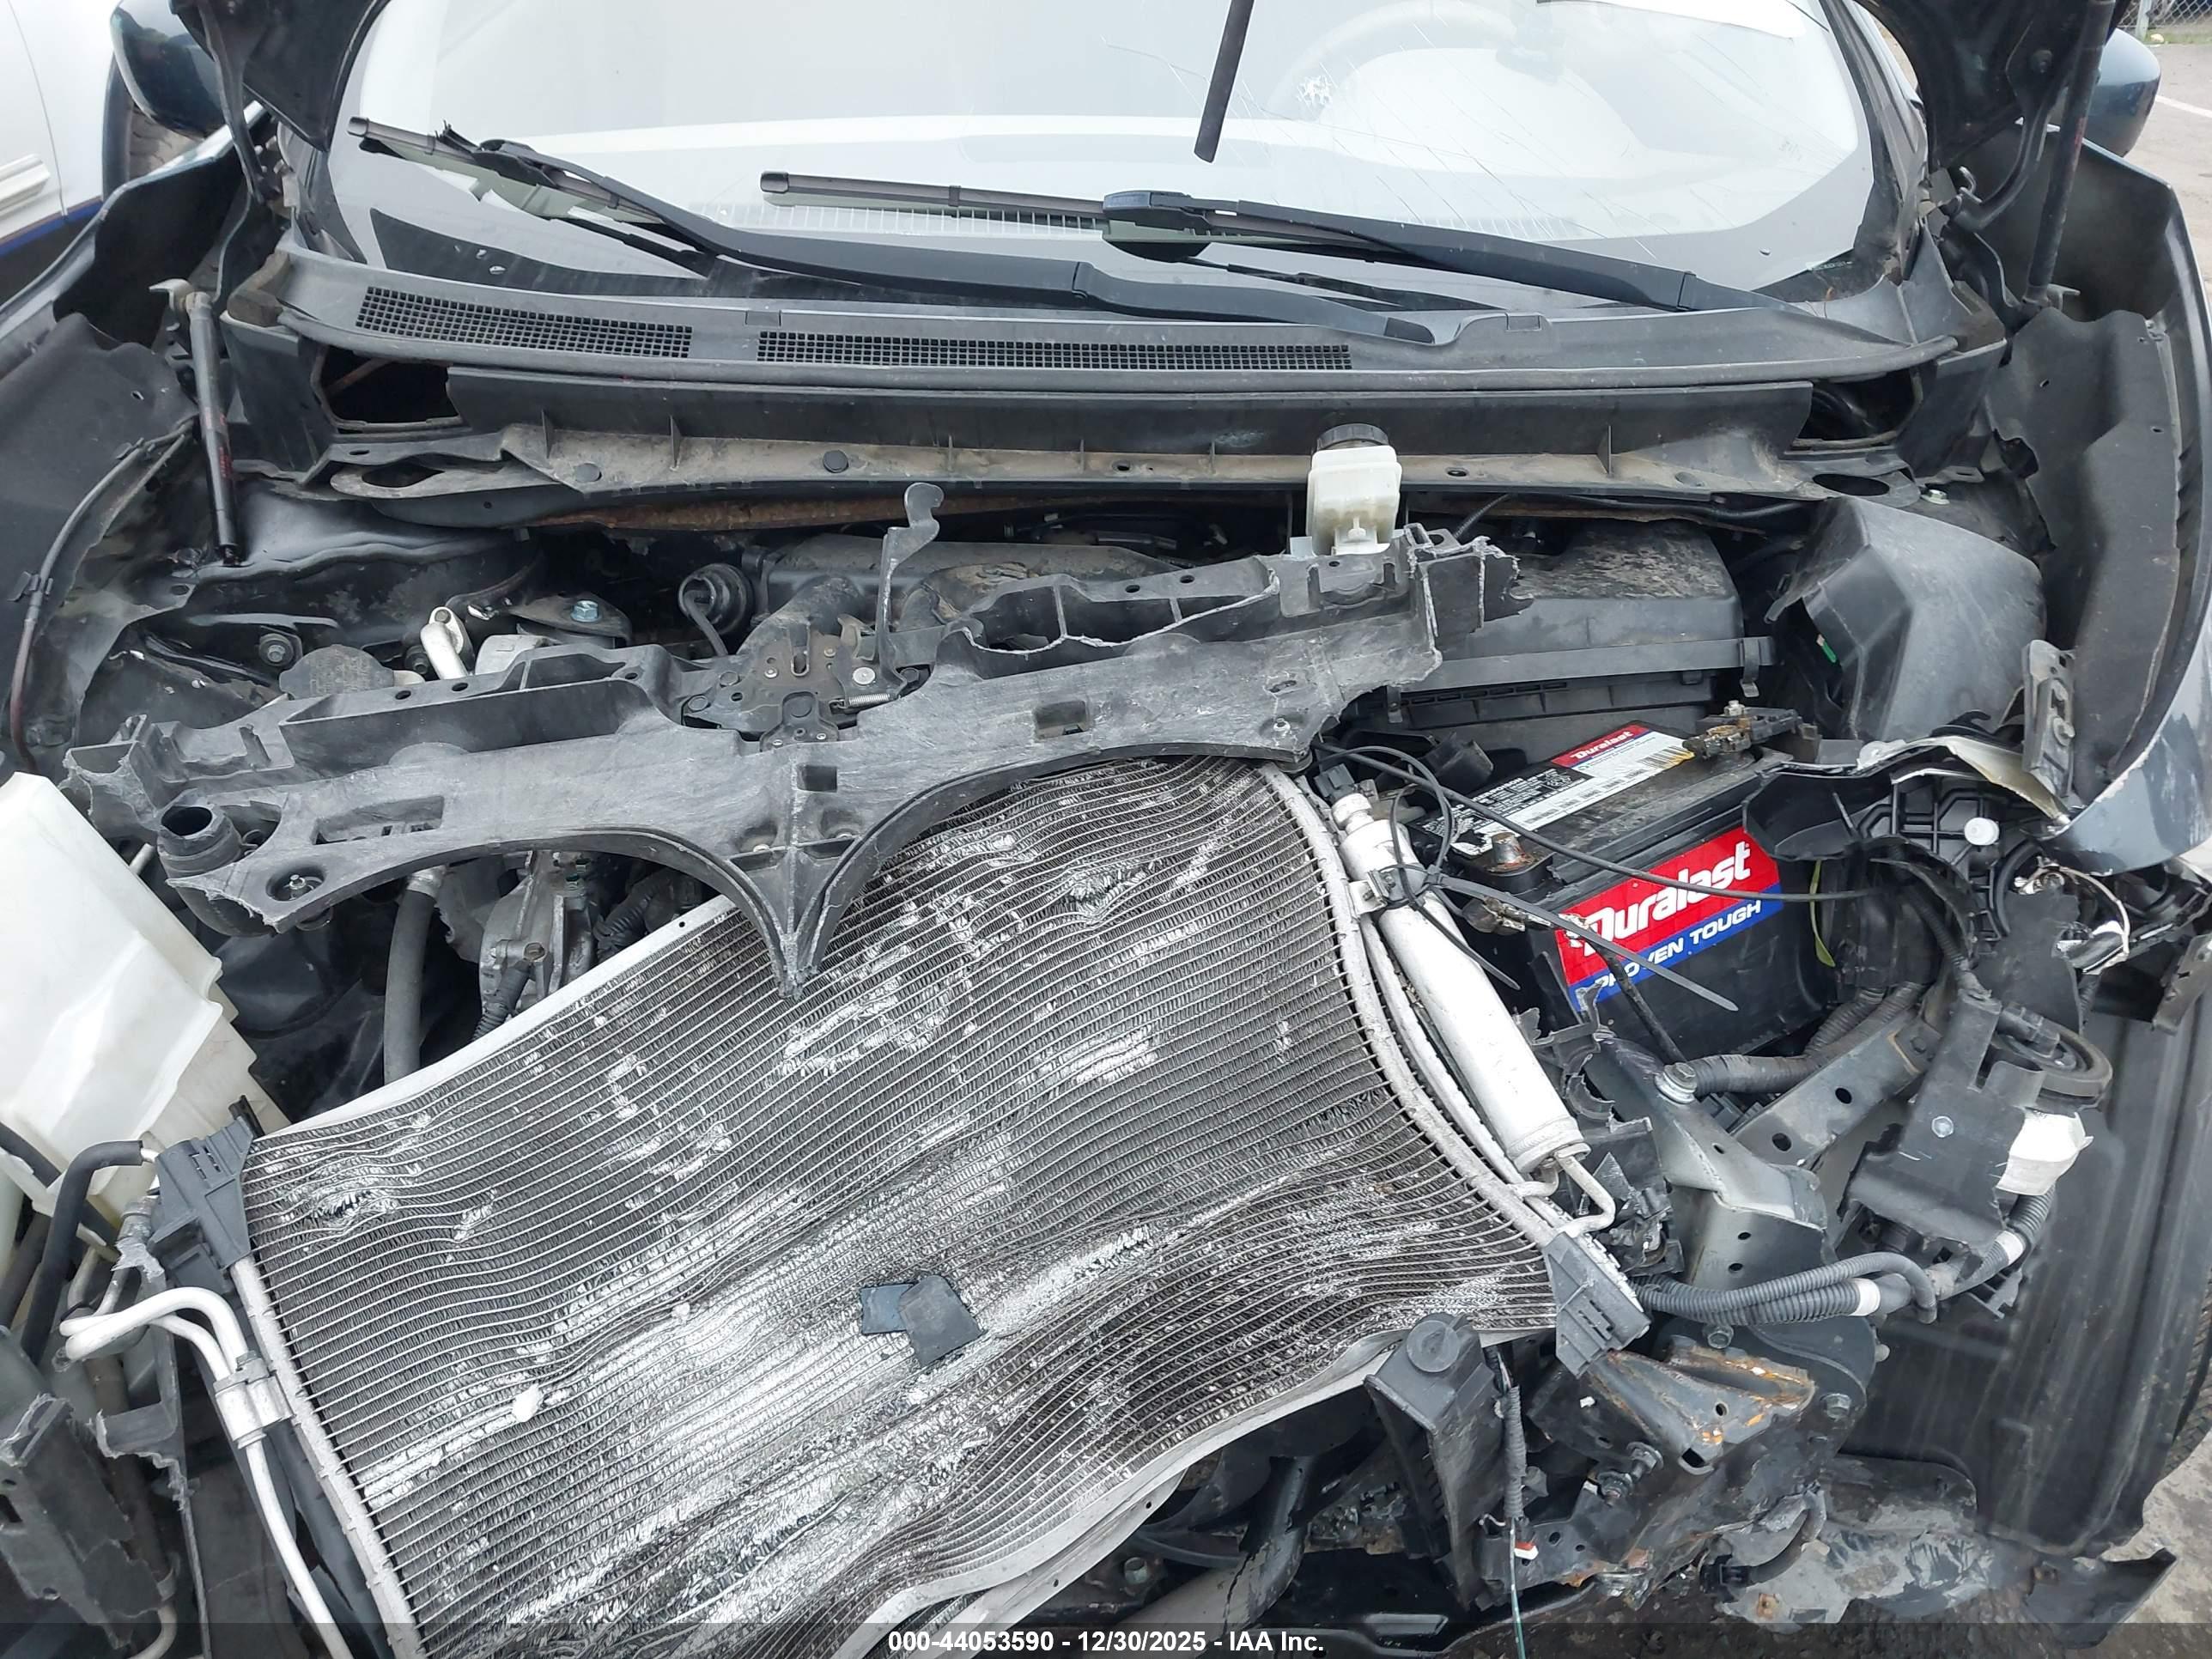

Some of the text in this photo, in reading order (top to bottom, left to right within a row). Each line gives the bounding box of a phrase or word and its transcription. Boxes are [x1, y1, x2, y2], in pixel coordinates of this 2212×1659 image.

[1570, 730, 1634, 759] Duralast
[1565, 841, 1751, 957] Duralast
[1690, 899, 1761, 945] TOUGH
